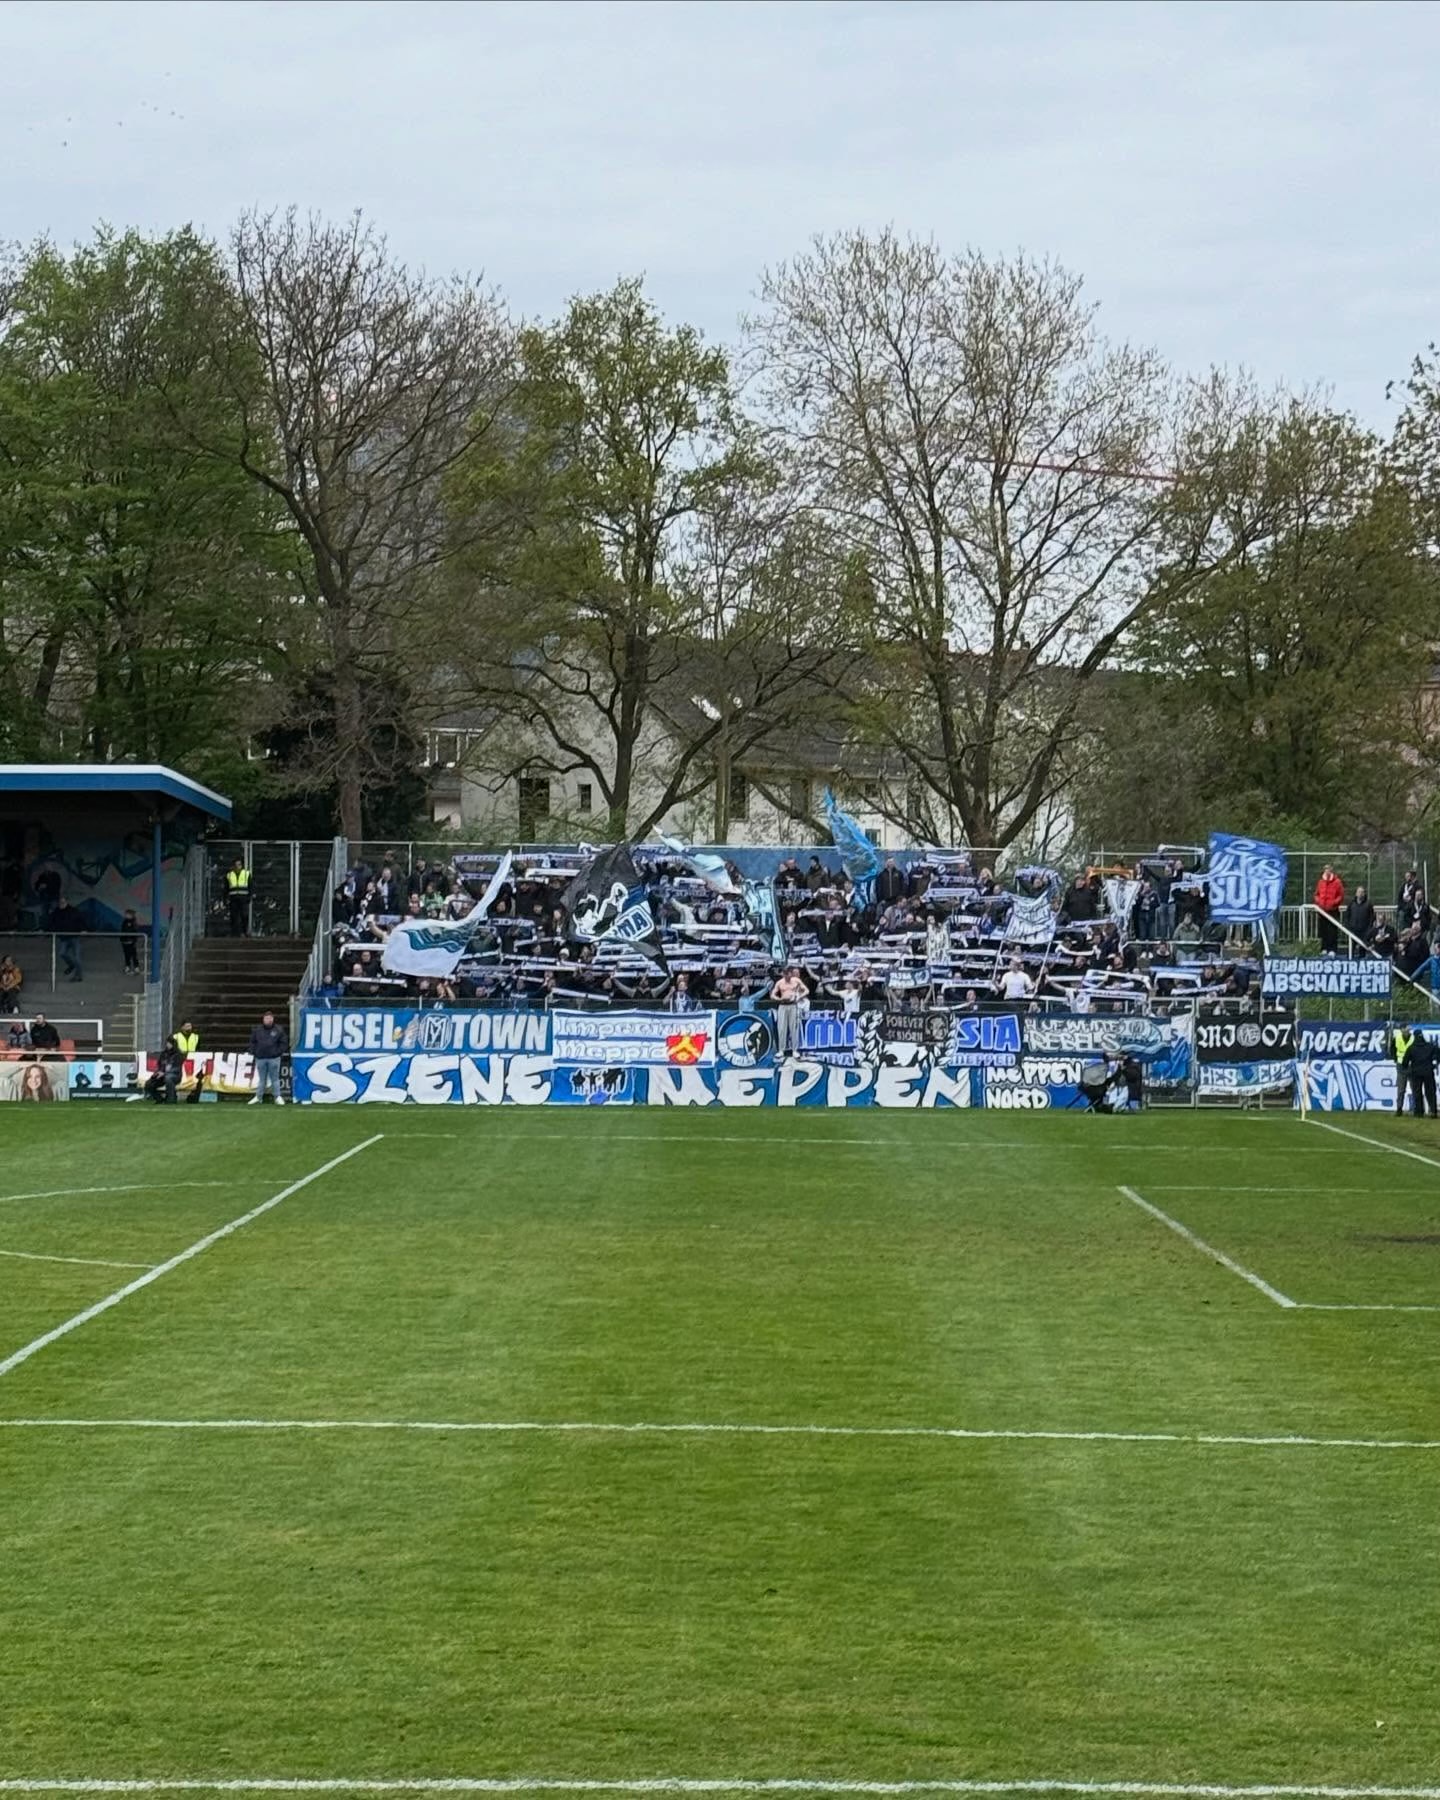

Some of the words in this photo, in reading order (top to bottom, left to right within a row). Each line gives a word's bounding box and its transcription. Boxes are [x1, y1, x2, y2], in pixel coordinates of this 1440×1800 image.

[1263, 958, 1390, 975] VERBANDSSTRAFEN
[1262, 973, 1390, 993] ABSCHAFFEN!
[305, 1013, 395, 1050] FUSEL
[451, 1014, 549, 1051] TOWN
[886, 1014, 923, 1029] FOREVER
[1262, 1023, 1292, 1047] 07
[306, 1053, 558, 1105] SZENE
[647, 1059, 971, 1109] MEPPEN
[986, 1061, 1082, 1086] MEPPEN
[985, 1087, 1049, 1109] NORD
